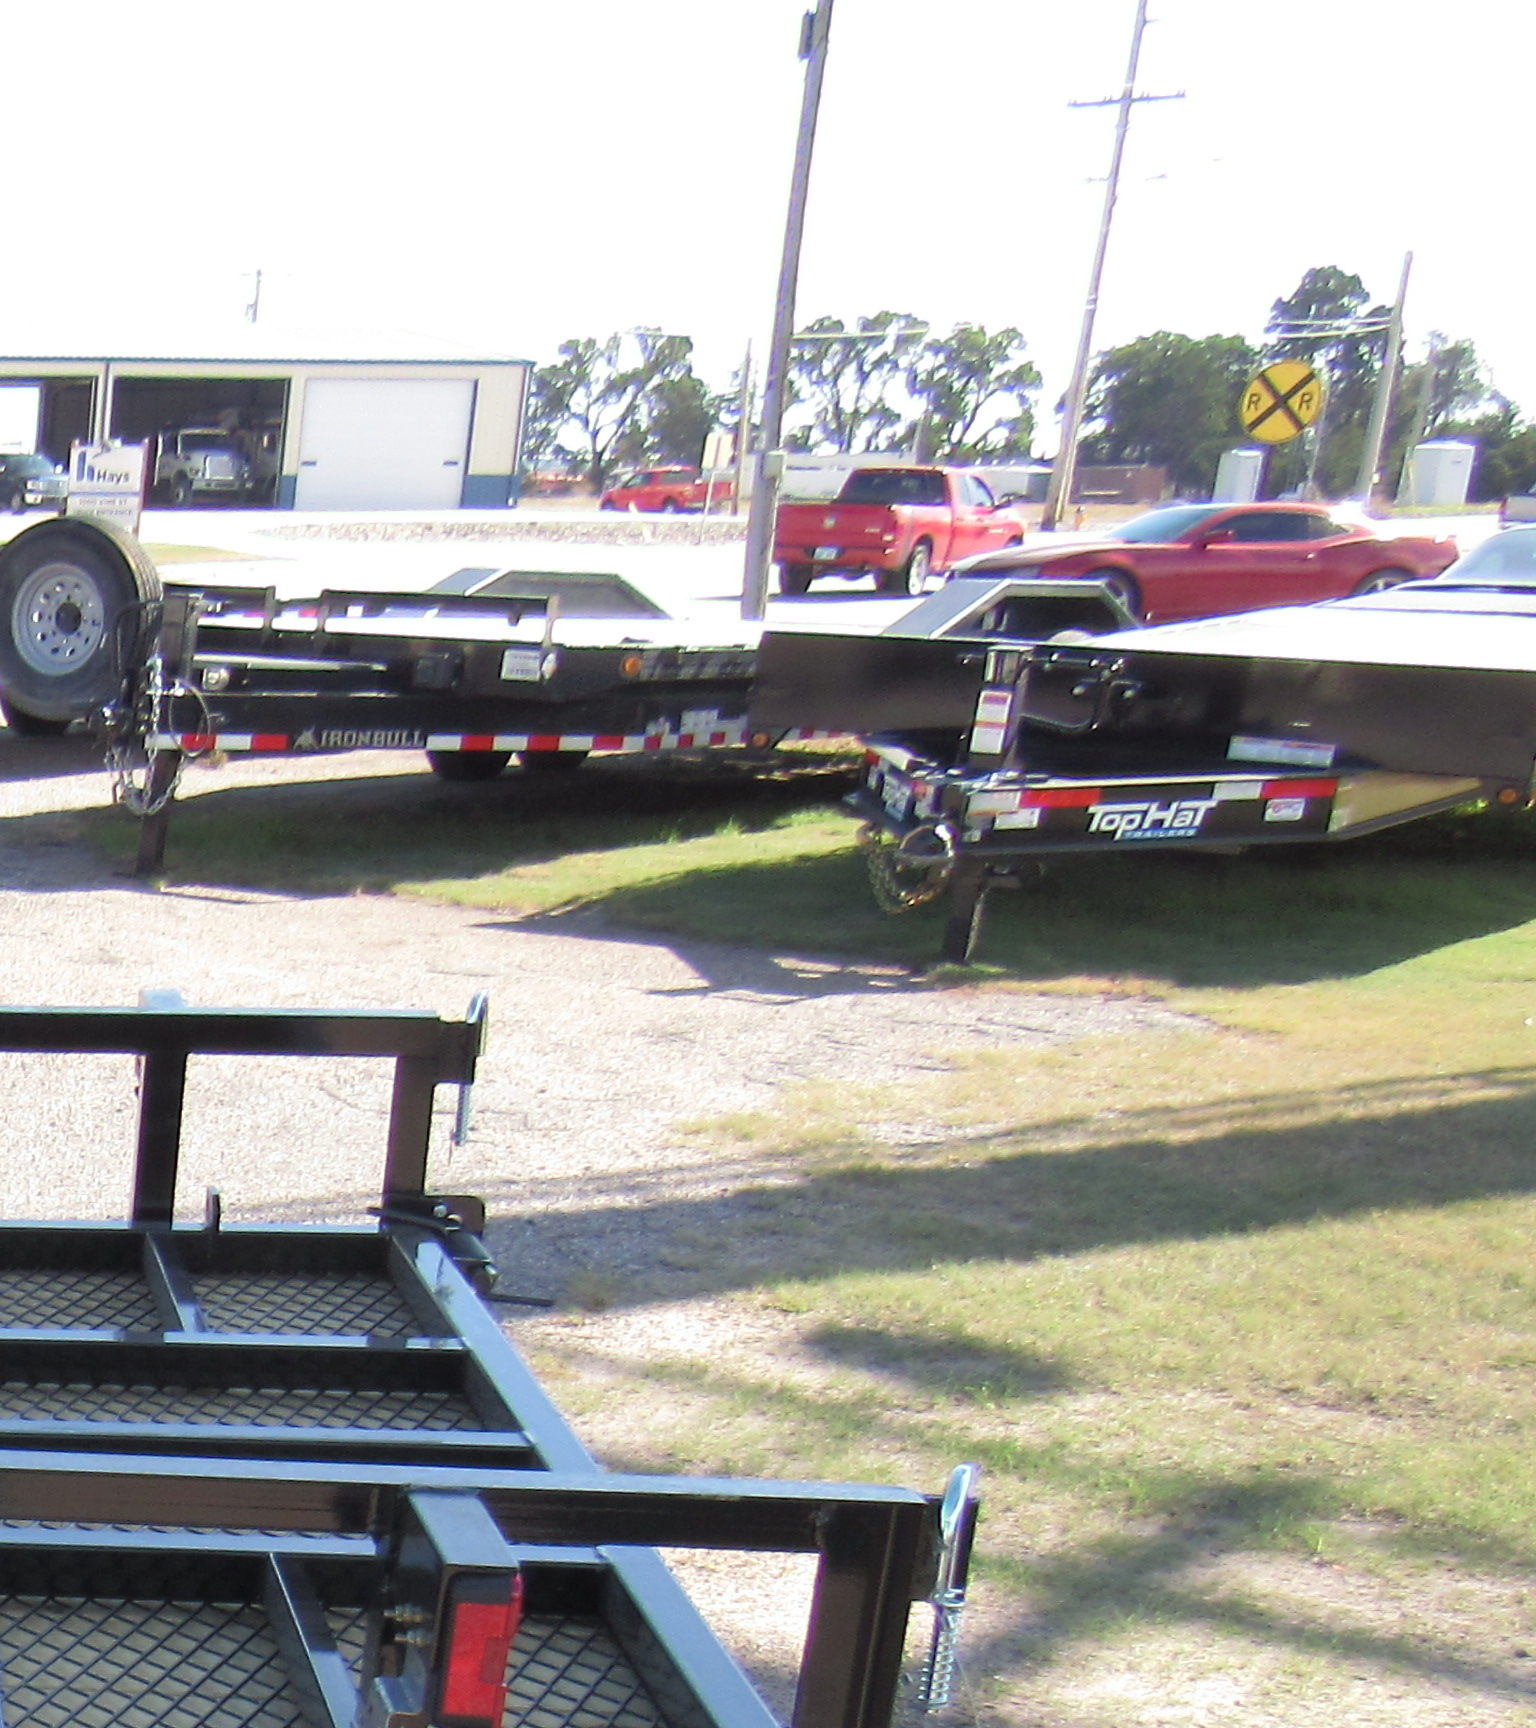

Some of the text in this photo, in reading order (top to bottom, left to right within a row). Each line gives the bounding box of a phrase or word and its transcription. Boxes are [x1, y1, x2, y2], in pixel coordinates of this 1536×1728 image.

[1247, 392, 1312, 412] R R
[97, 469, 129, 484] Hays
